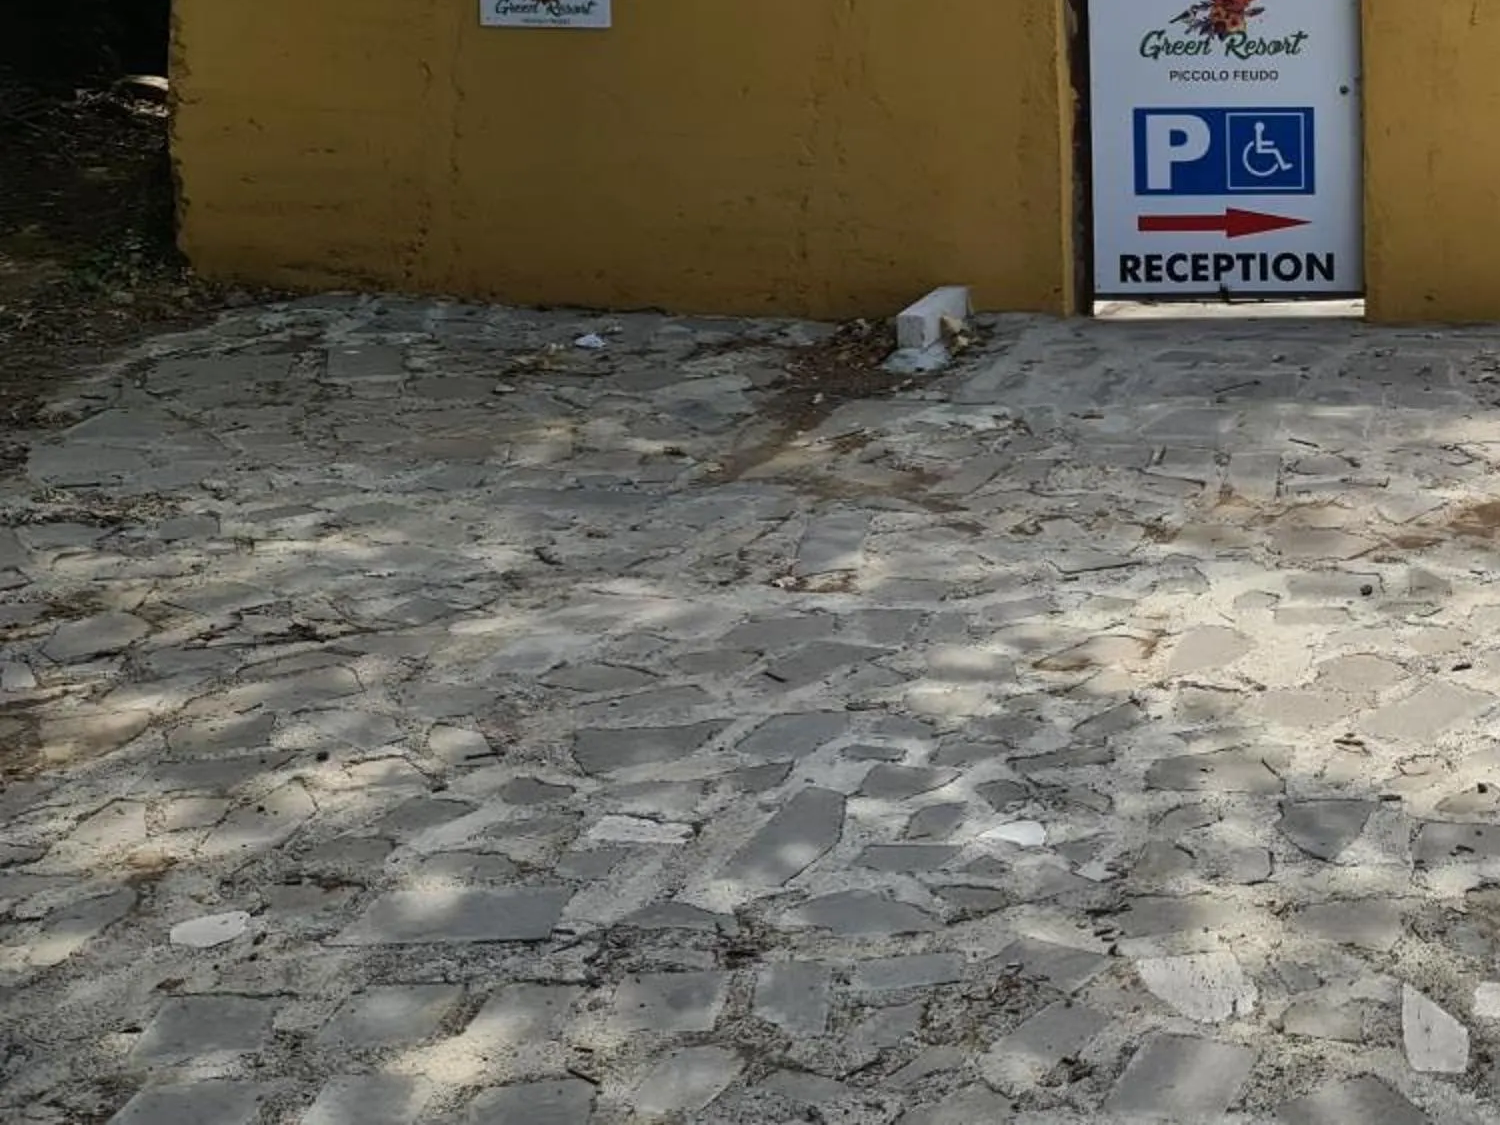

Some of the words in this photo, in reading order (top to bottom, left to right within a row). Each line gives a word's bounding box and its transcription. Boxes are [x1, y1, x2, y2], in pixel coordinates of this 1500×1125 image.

[1139, 30, 1211, 60] Green
[1223, 31, 1308, 60] Resort
[1169, 70, 1229, 82] PICCOLO
[1233, 70, 1279, 82] FEUDO
[1145, 114, 1211, 190] P
[1119, 253, 1335, 283] RECEPTION
